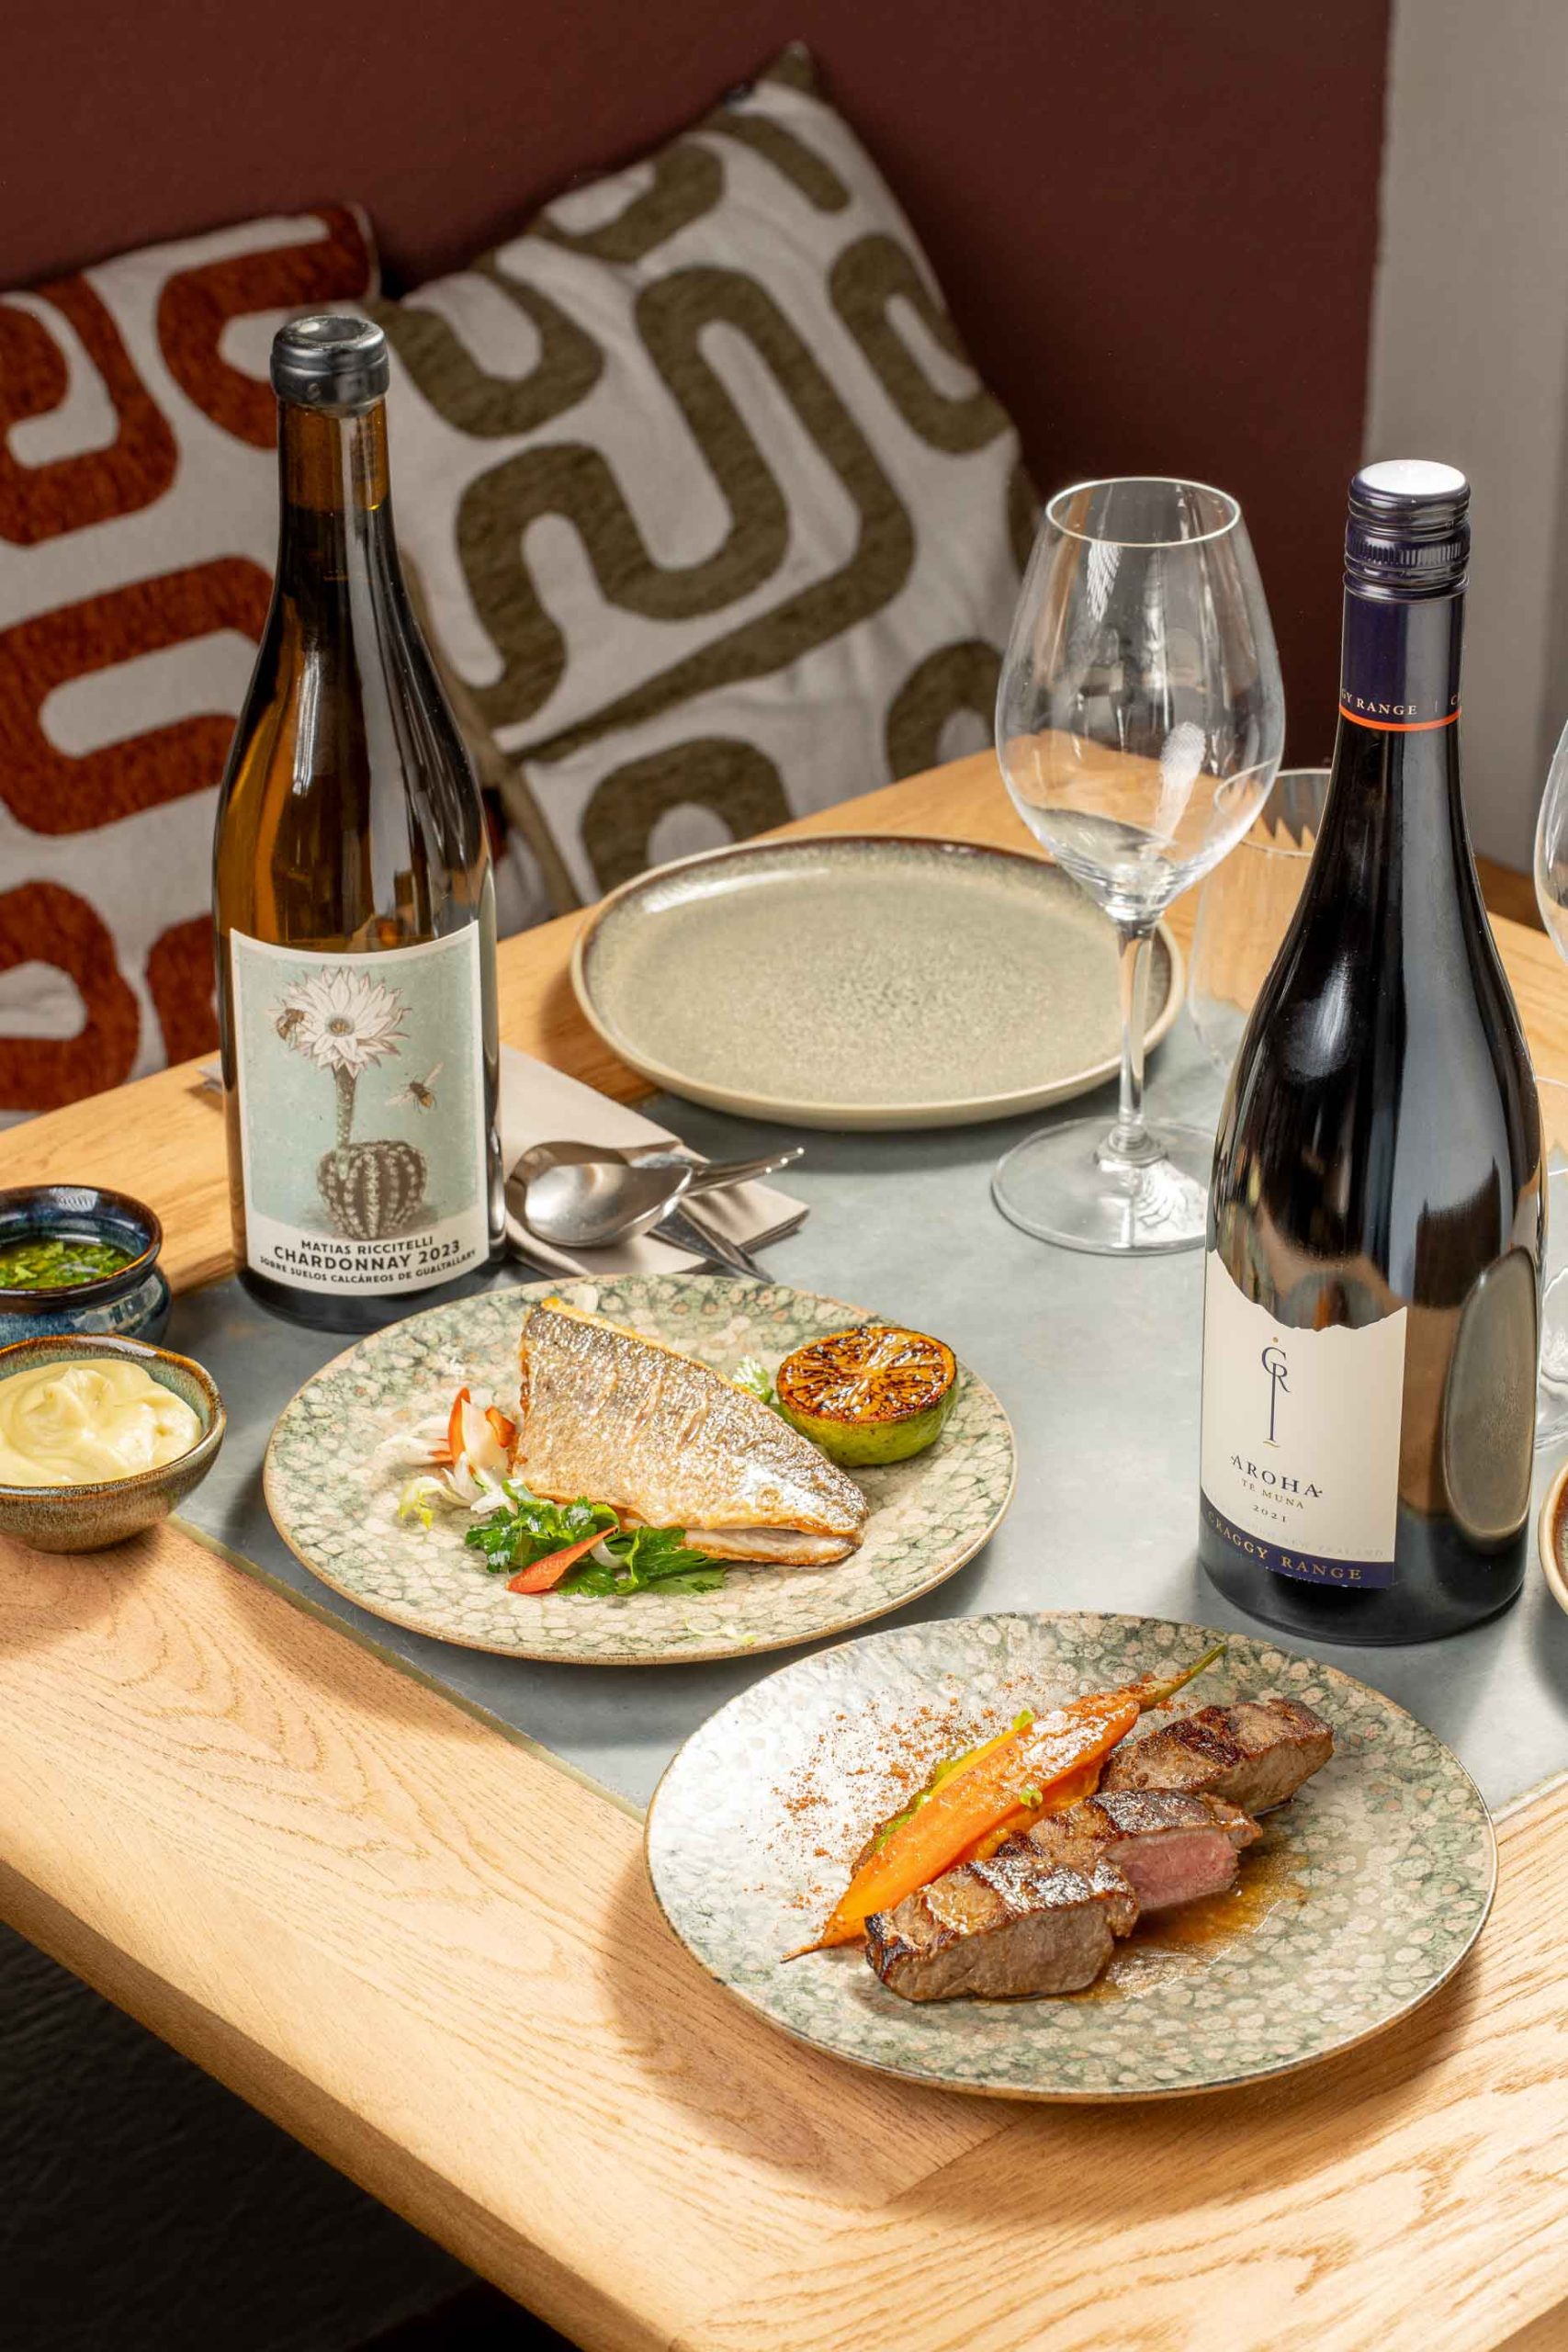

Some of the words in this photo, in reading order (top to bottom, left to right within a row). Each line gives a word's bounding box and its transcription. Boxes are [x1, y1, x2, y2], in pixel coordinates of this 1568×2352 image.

[1356, 698, 1418, 716] RANGE
[274, 1246, 412, 1271] CHARDONNAY
[418, 1239, 460, 1264] 2023
[301, 1239, 352, 1255] MATIAS
[357, 1236, 434, 1255] RICCITELLI
[259, 1256, 288, 1273] SOBRE
[290, 1267, 327, 1282] SUELOS
[331, 1272, 394, 1284] CALCÁREOS
[398, 1272, 412, 1281] DE
[415, 1250, 476, 1277] GUALTALLARY
[1230, 1454, 1324, 1498] AROHA
[1242, 1478, 1257, 1492] TE
[1262, 1489, 1304, 1510] MUNA
[1252, 1504, 1287, 1523] 2021
[1280, 1555, 1362, 1580] RANGE
